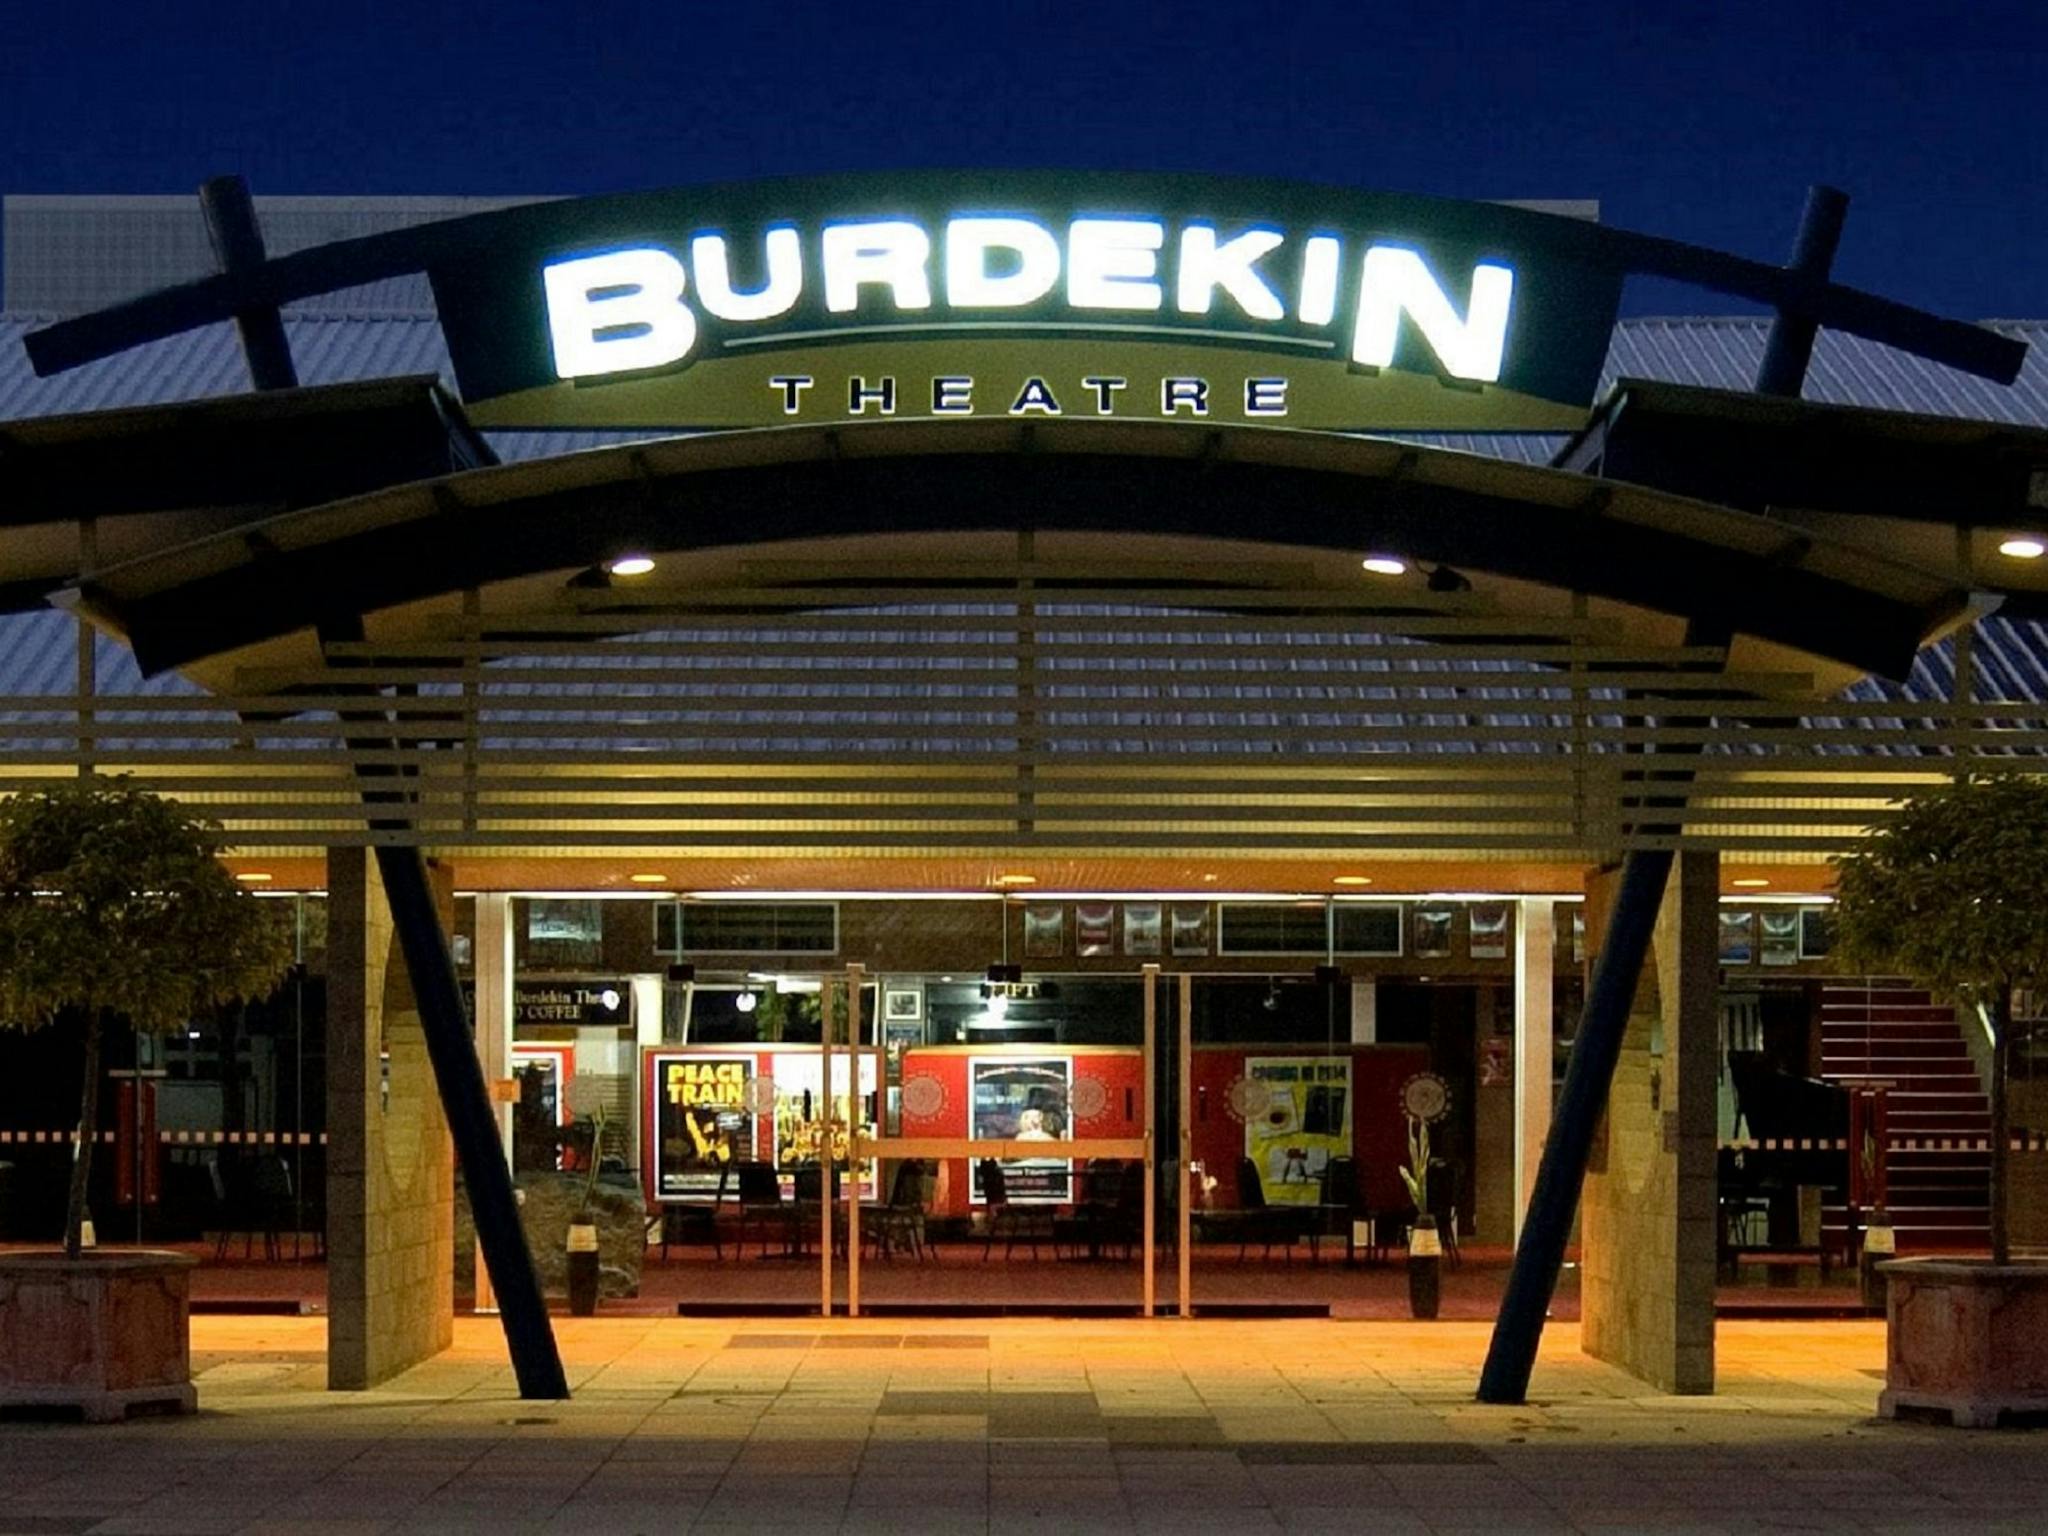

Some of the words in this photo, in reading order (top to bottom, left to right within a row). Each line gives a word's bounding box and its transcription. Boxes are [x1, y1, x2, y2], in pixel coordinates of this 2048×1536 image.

[543, 211, 1514, 382] BURDEKIN
[768, 375, 1290, 417] THEATRE
[667, 1063, 743, 1084] PEACE
[667, 1083, 744, 1106] TRAIN
